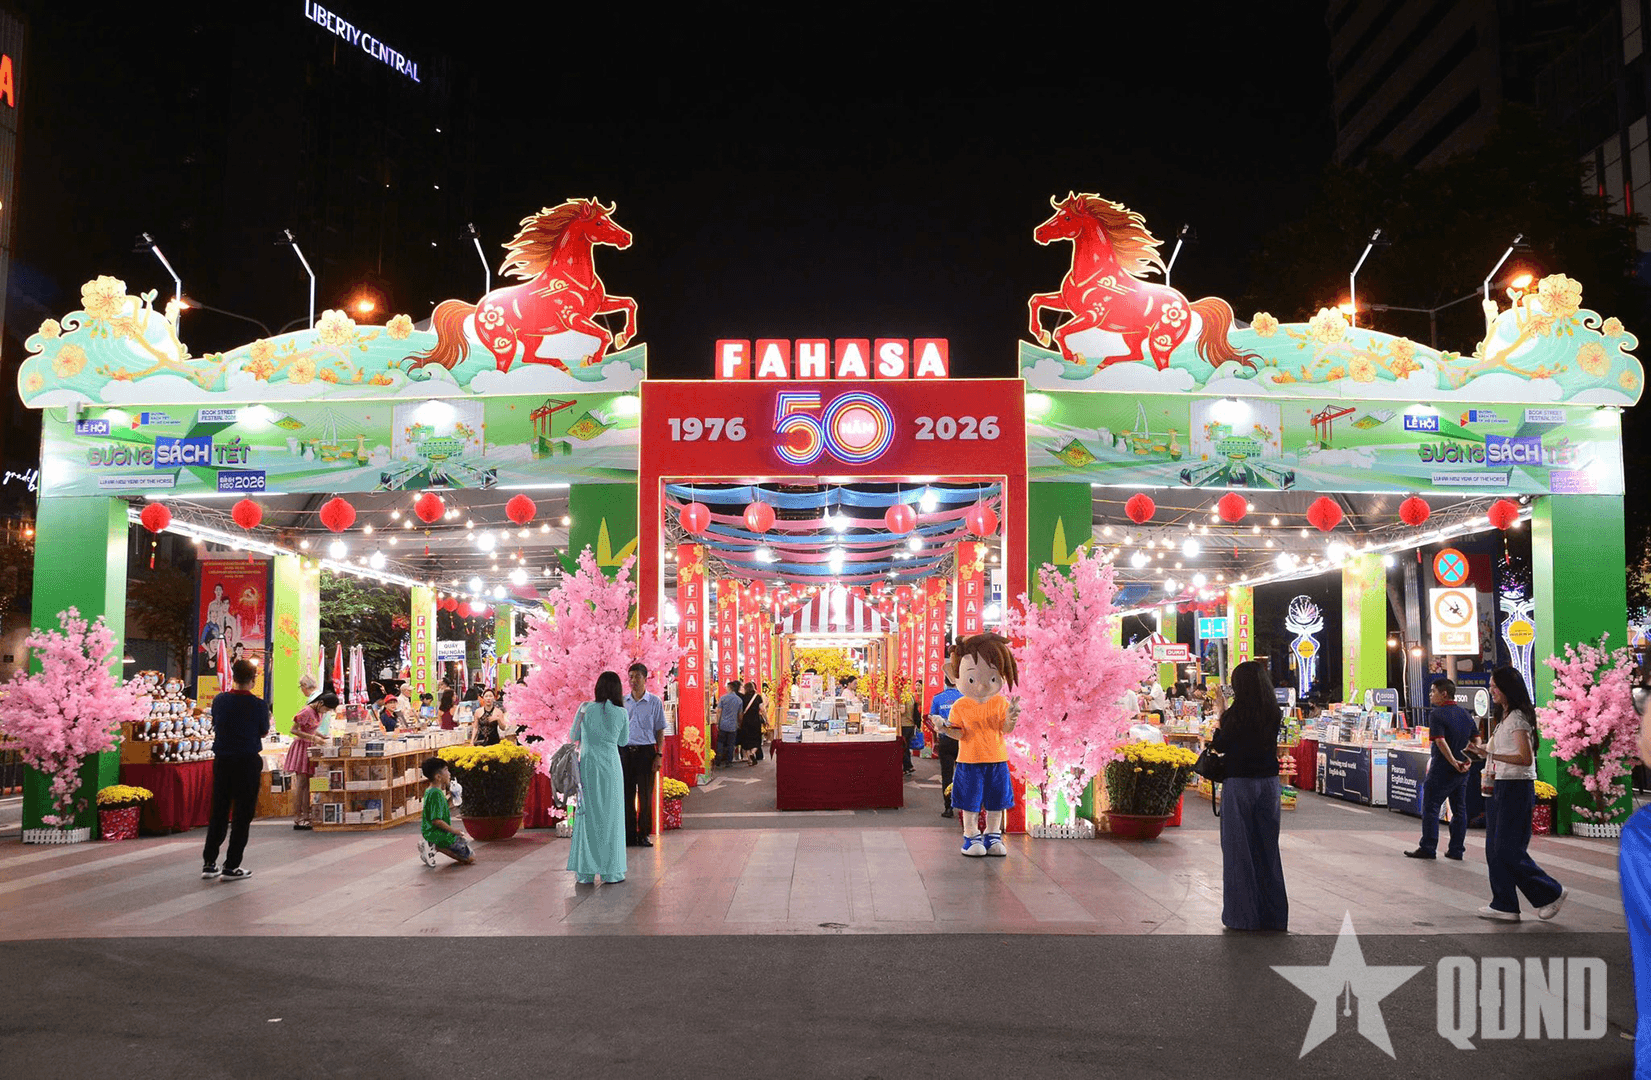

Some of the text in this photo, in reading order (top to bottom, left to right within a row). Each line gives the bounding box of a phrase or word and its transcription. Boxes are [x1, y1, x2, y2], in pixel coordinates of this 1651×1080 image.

[305, 0, 421, 83] LIBERTY CENTRAL
[722, 342, 947, 378] FAHASA
[90, 422, 107, 433] HỘI
[668, 417, 747, 441] 1976
[773, 390, 897, 466] 50
[841, 418, 875, 434] NĂM
[914, 416, 1001, 441] 2026
[1419, 418, 1436, 430] HỘI
[87, 435, 252, 467] ĐƯỜNG SÁCH TẾT
[1418, 439, 1486, 463] ĐƯỜNG
[1488, 438, 1540, 463] SÁCH
[235, 476, 265, 489] 2026
[966, 582, 976, 631] FAH
[686, 584, 698, 687] FAHASA
[930, 608, 940, 686] FAHASA
[1240, 615, 1248, 662] FAHA
[417, 616, 425, 692] FAHASA
[1454, 694, 1468, 703] arson
[1391, 764, 1406, 774] Pearson
[1391, 774, 1417, 788] English Journey
